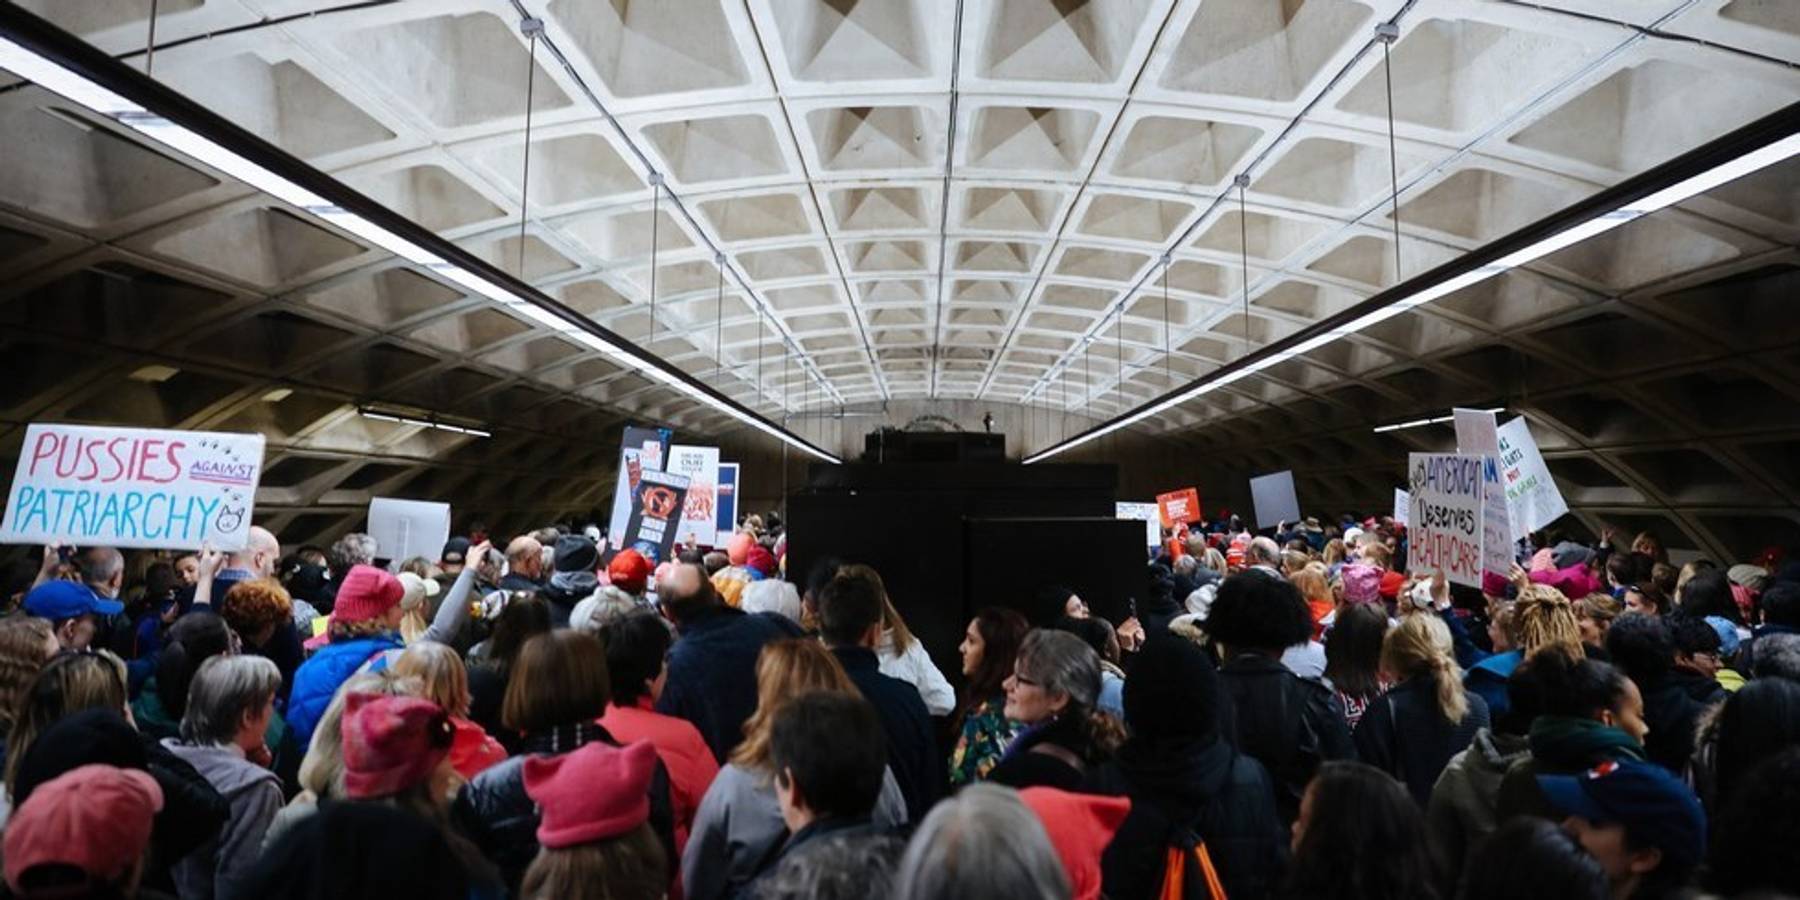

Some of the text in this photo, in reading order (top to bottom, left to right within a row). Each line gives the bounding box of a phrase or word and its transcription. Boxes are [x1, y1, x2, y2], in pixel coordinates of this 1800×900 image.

[29, 431, 255, 484] PUSSIES AGAINST
[13, 486, 219, 540] PATRIARCHY
[1419, 498, 1476, 535] Deserves
[1409, 527, 1480, 577] HEALTHCARE
